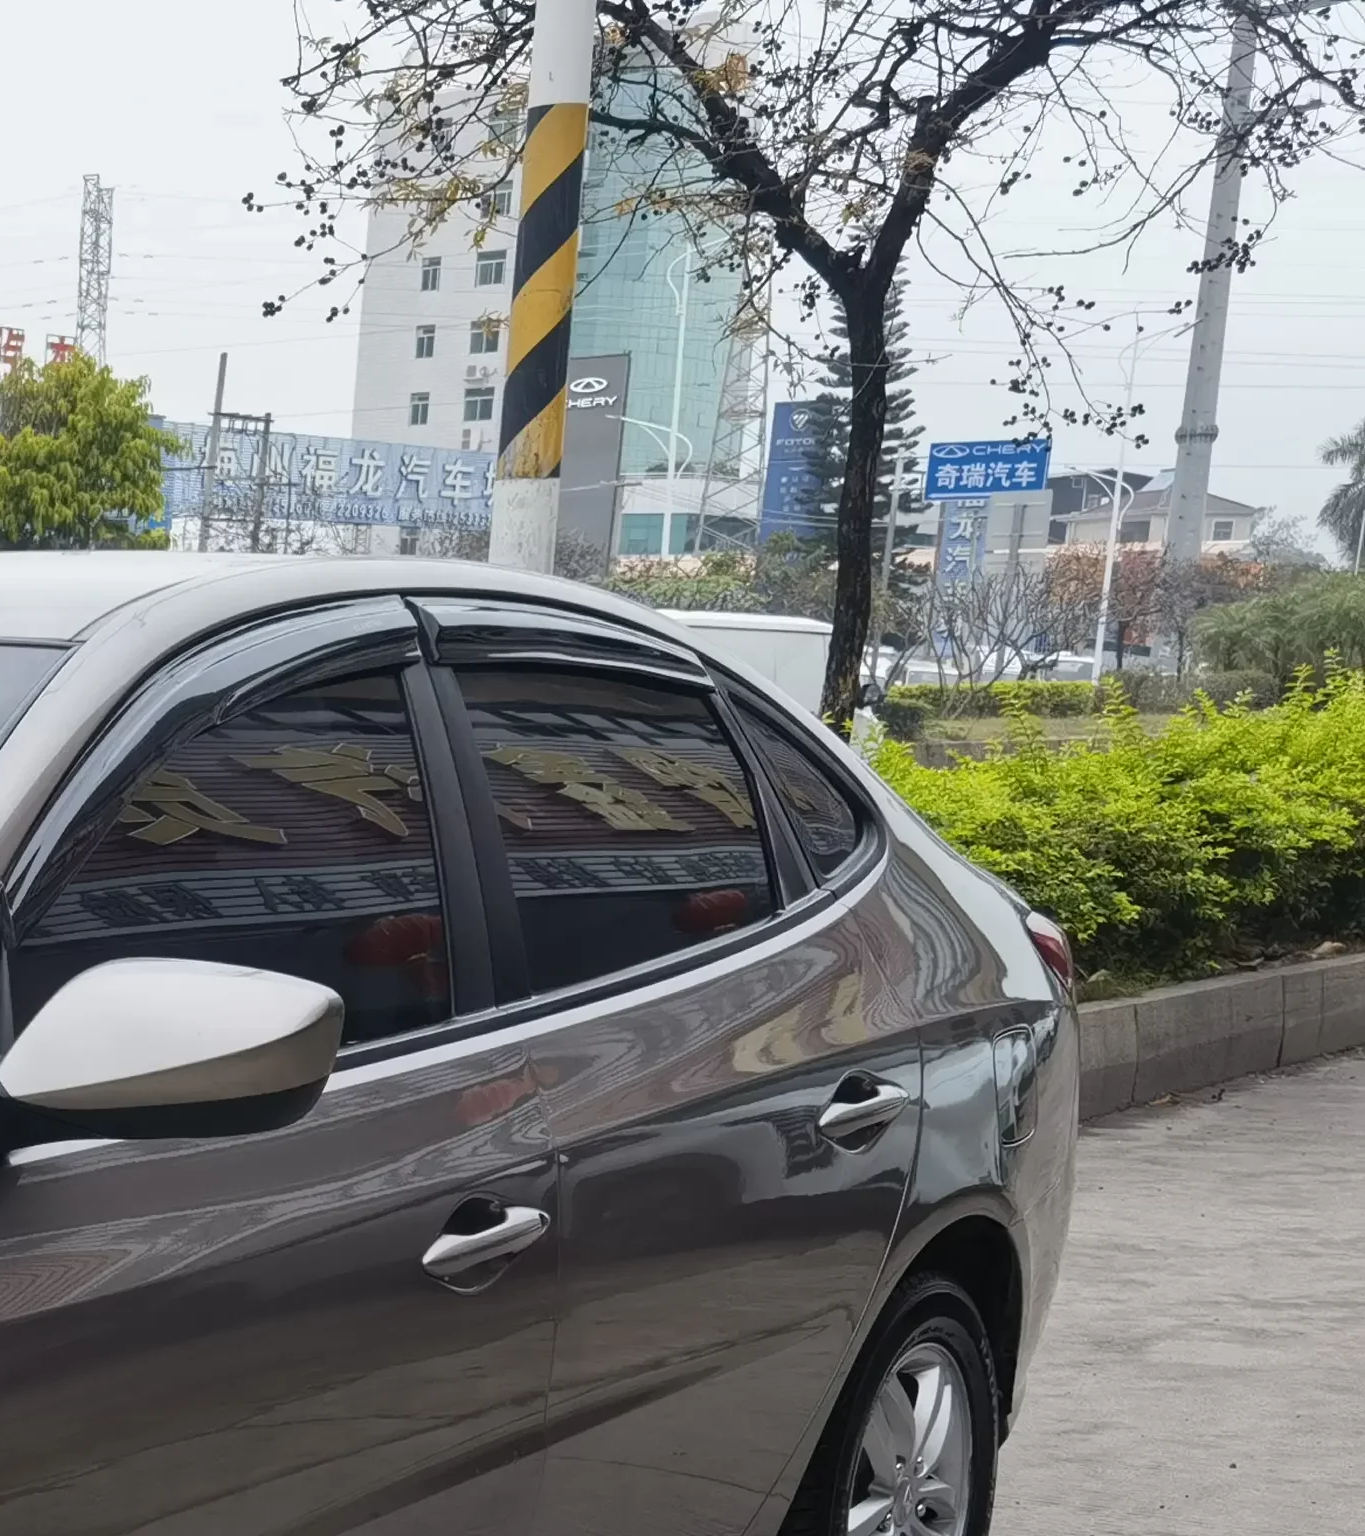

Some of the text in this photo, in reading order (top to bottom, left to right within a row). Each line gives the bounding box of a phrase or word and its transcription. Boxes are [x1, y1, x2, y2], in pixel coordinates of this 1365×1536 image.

[568, 396, 617, 409] HERY
[776, 437, 815, 446] FOTO
[972, 443, 1046, 456] CHERY
[935, 460, 1038, 490] 奇瑞汽车
